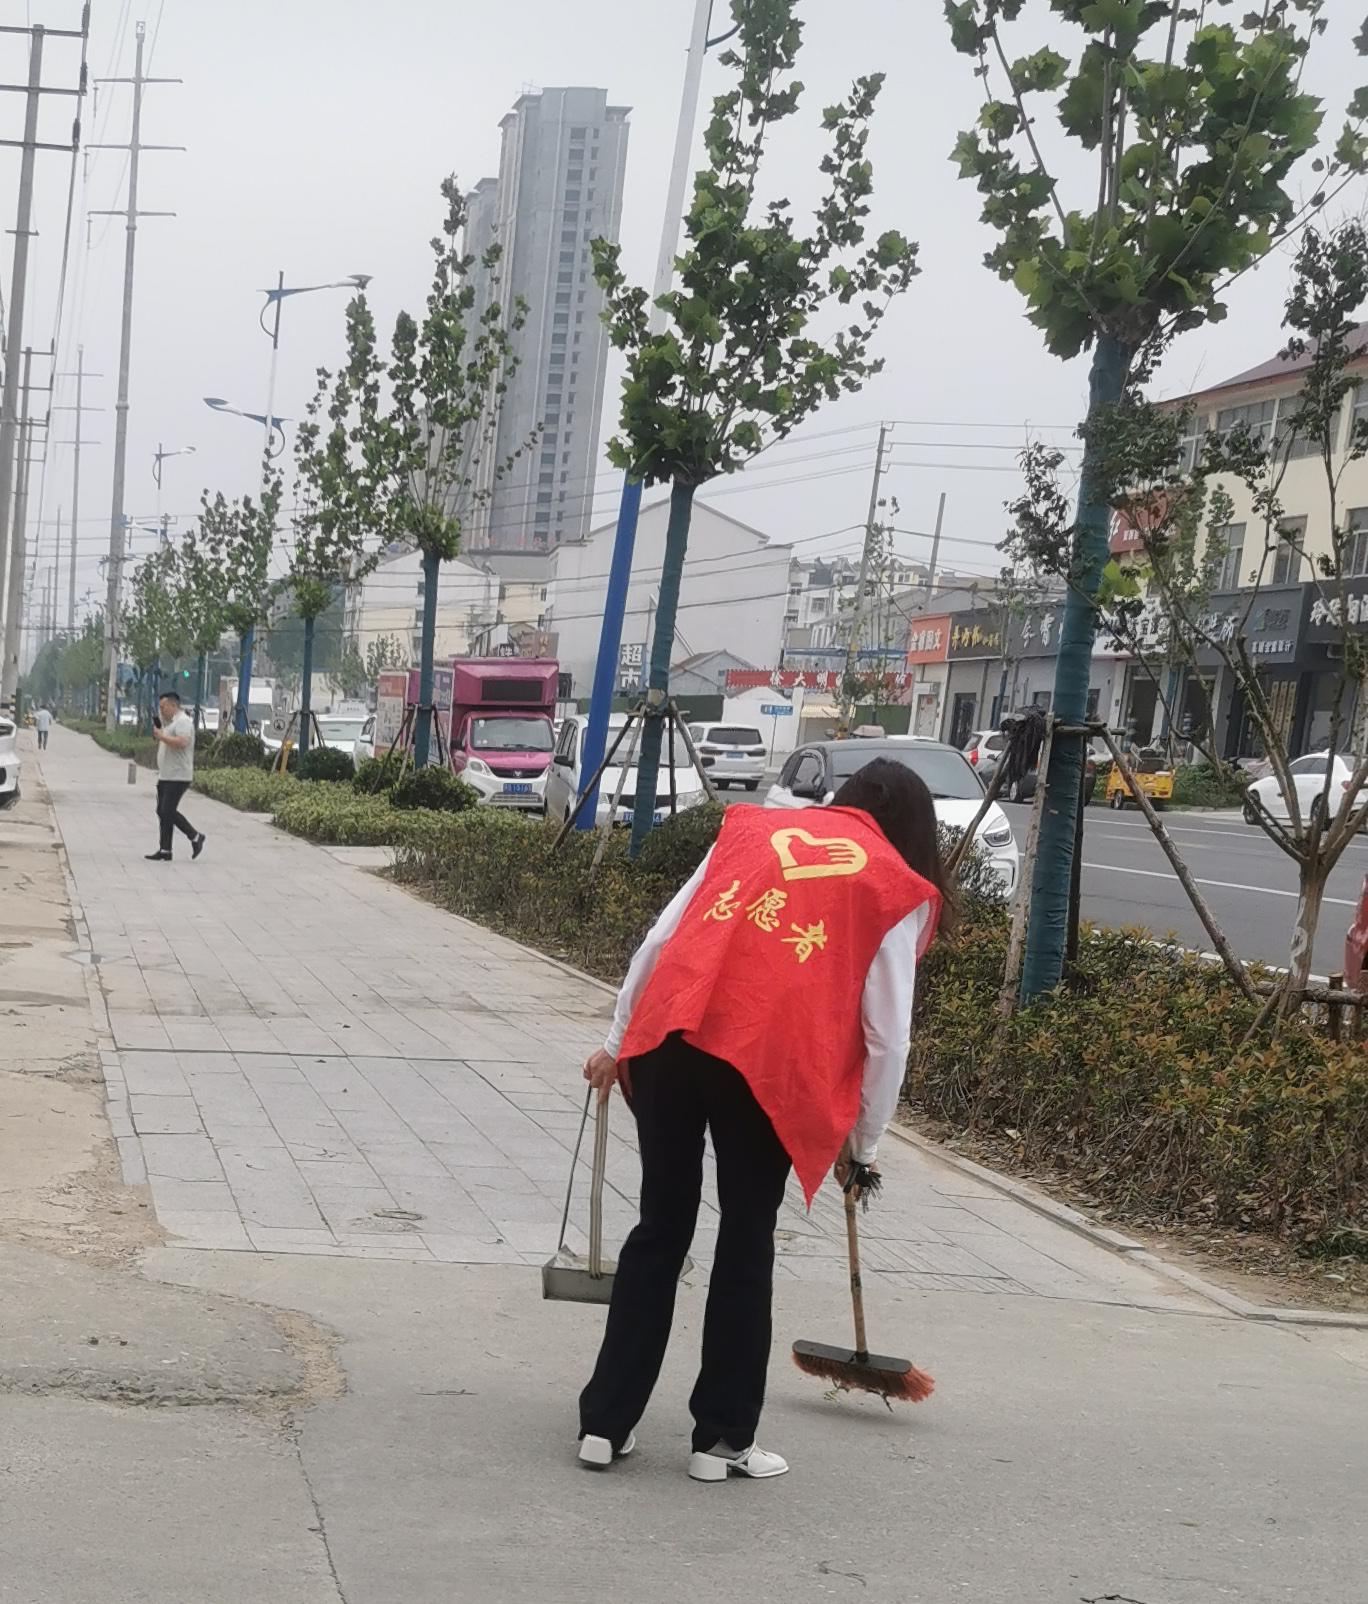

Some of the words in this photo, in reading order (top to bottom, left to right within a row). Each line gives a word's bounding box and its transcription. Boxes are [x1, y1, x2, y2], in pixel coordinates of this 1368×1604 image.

[620, 643, 643, 688] 超市
[703, 879, 828, 964] 志愿者
